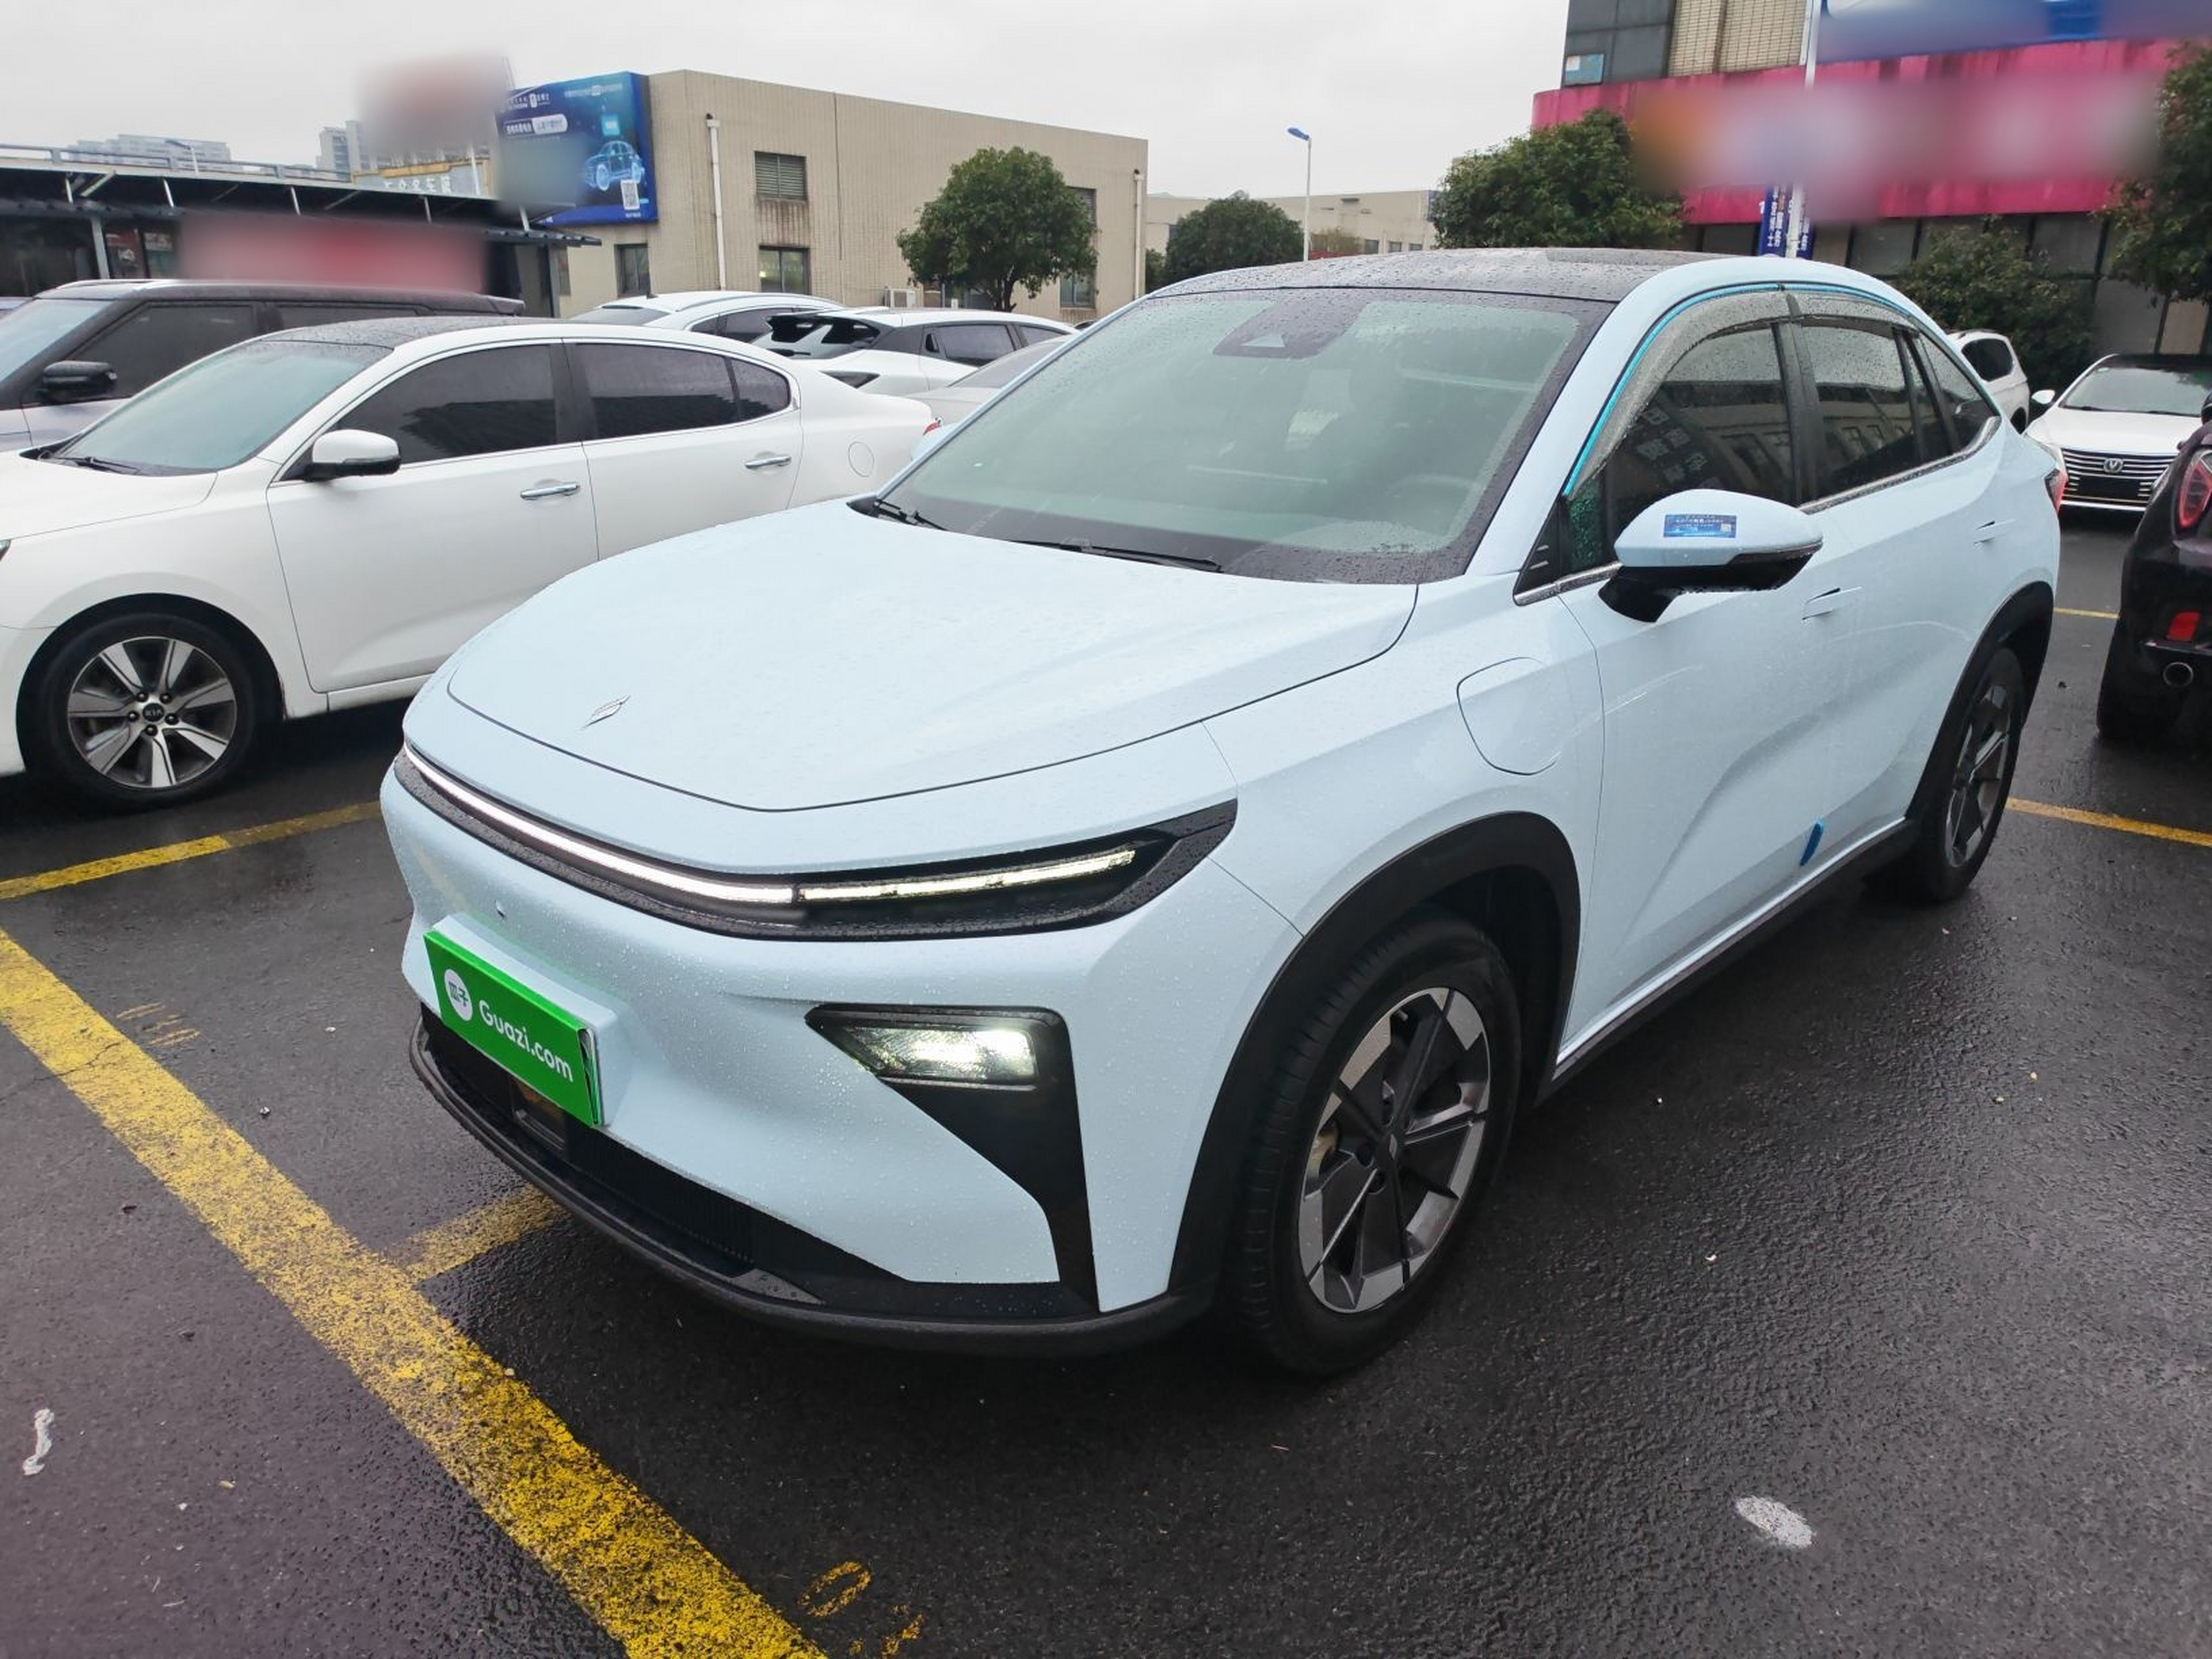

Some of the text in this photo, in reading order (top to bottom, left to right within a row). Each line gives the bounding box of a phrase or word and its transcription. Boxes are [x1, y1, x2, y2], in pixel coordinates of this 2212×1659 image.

[145, 708, 163, 717] KIA
[448, 980, 468, 1007] 瓜子
[479, 999, 574, 1083] Guazi.com
